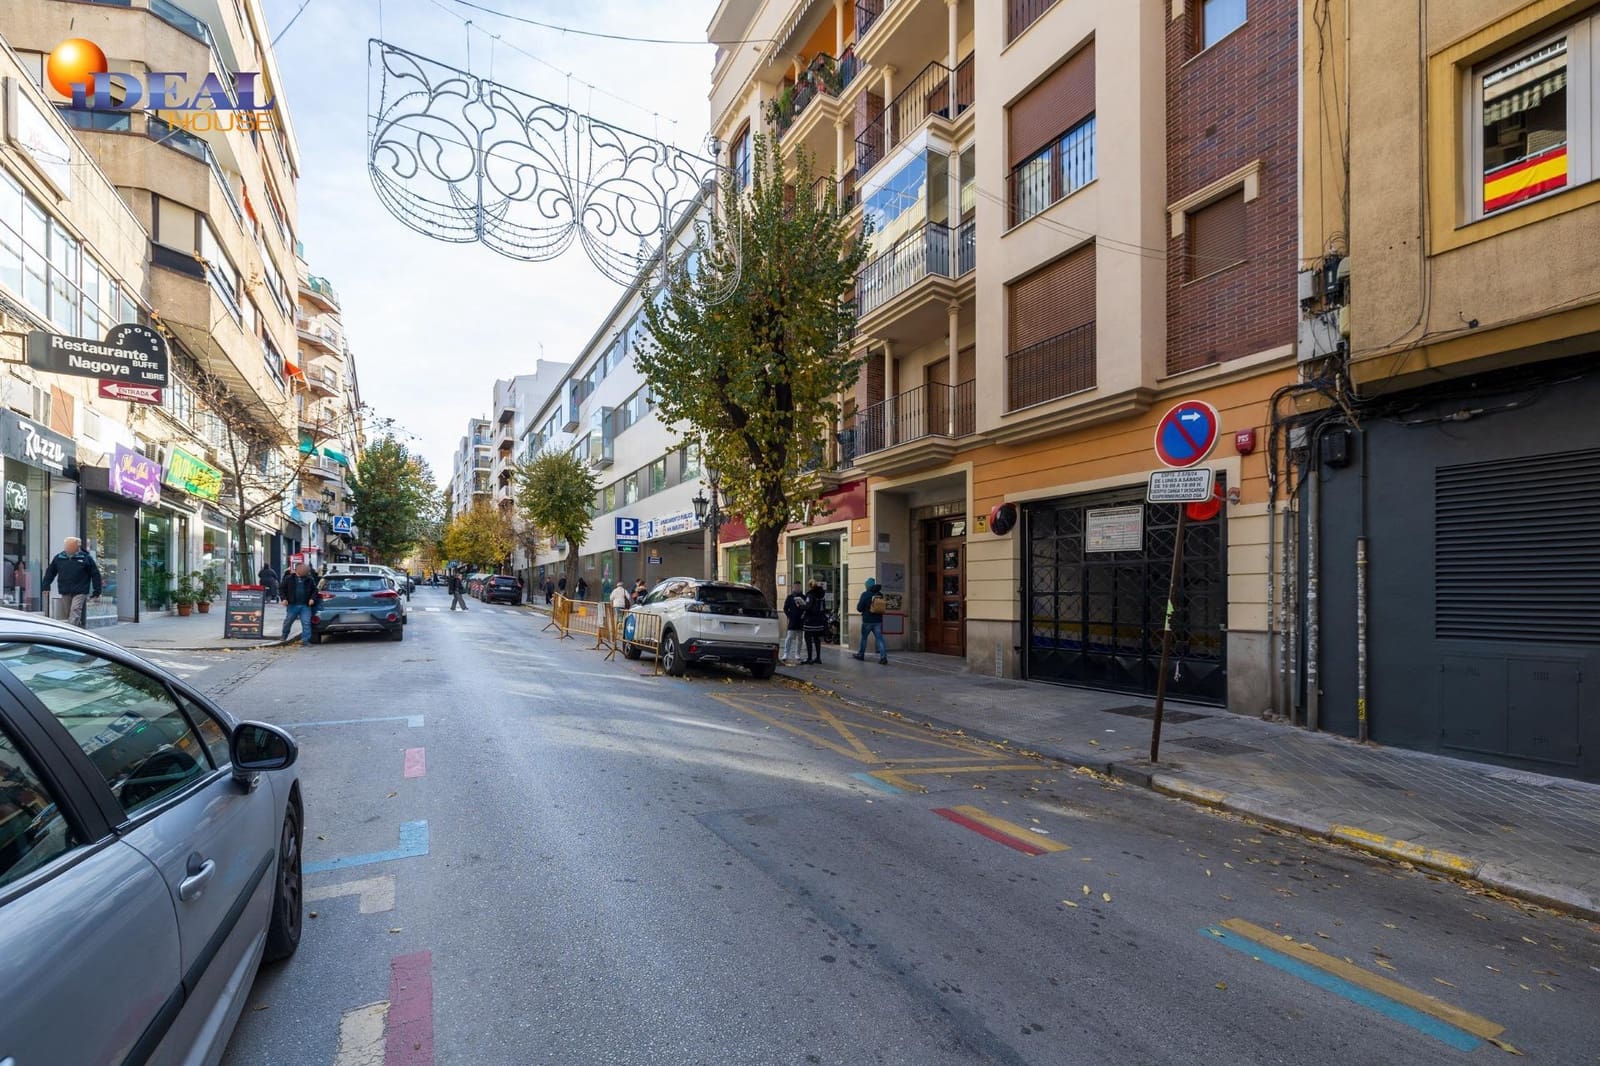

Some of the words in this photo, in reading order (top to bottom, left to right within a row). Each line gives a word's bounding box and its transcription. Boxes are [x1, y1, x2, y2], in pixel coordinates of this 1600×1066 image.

[51, 335, 149, 362] Restaurante
[68, 354, 131, 376] Nagoya
[132, 360, 159, 370] BUFFE
[141, 372, 165, 381] LIBRE
[118, 387, 150, 397] ENTRADA
